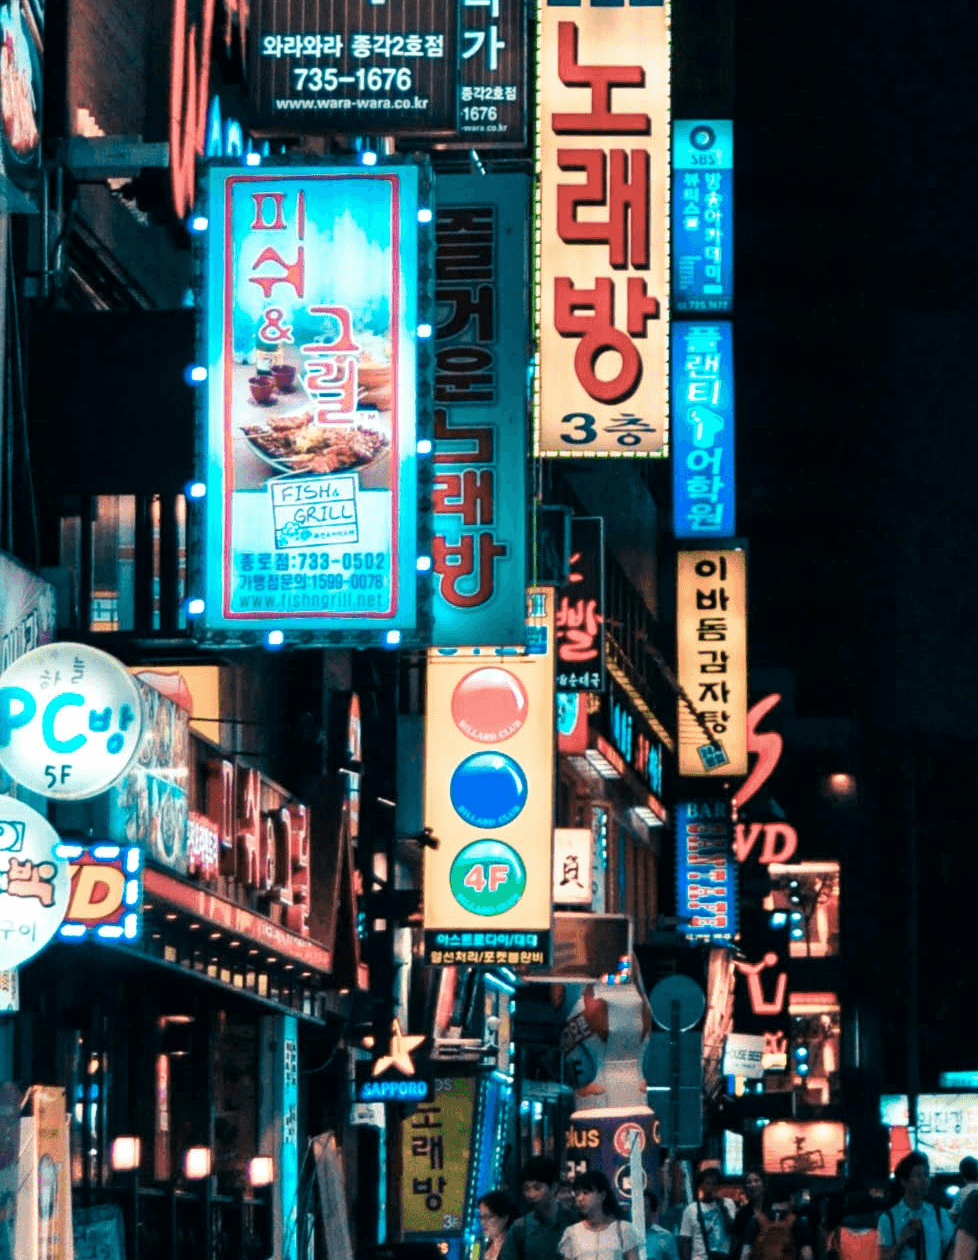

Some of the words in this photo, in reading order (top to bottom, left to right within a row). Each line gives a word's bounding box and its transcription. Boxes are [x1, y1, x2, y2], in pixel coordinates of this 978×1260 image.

[263, 35, 342, 58] 와라와라
[352, 35, 444, 58] 종각2호점
[294, 68, 412, 92] 735-1676
[276, 96, 429, 110] www.wara-wara.co.kr
[551, 20, 661, 406] 노래방
[560, 411, 657, 446] 3층
[281, 483, 331, 502] FISH
[293, 505, 353, 525] GRILL
[44, 764, 73, 789] 5F
[463, 864, 510, 893] 4F
[361, 1080, 428, 1101] SAPPORO
